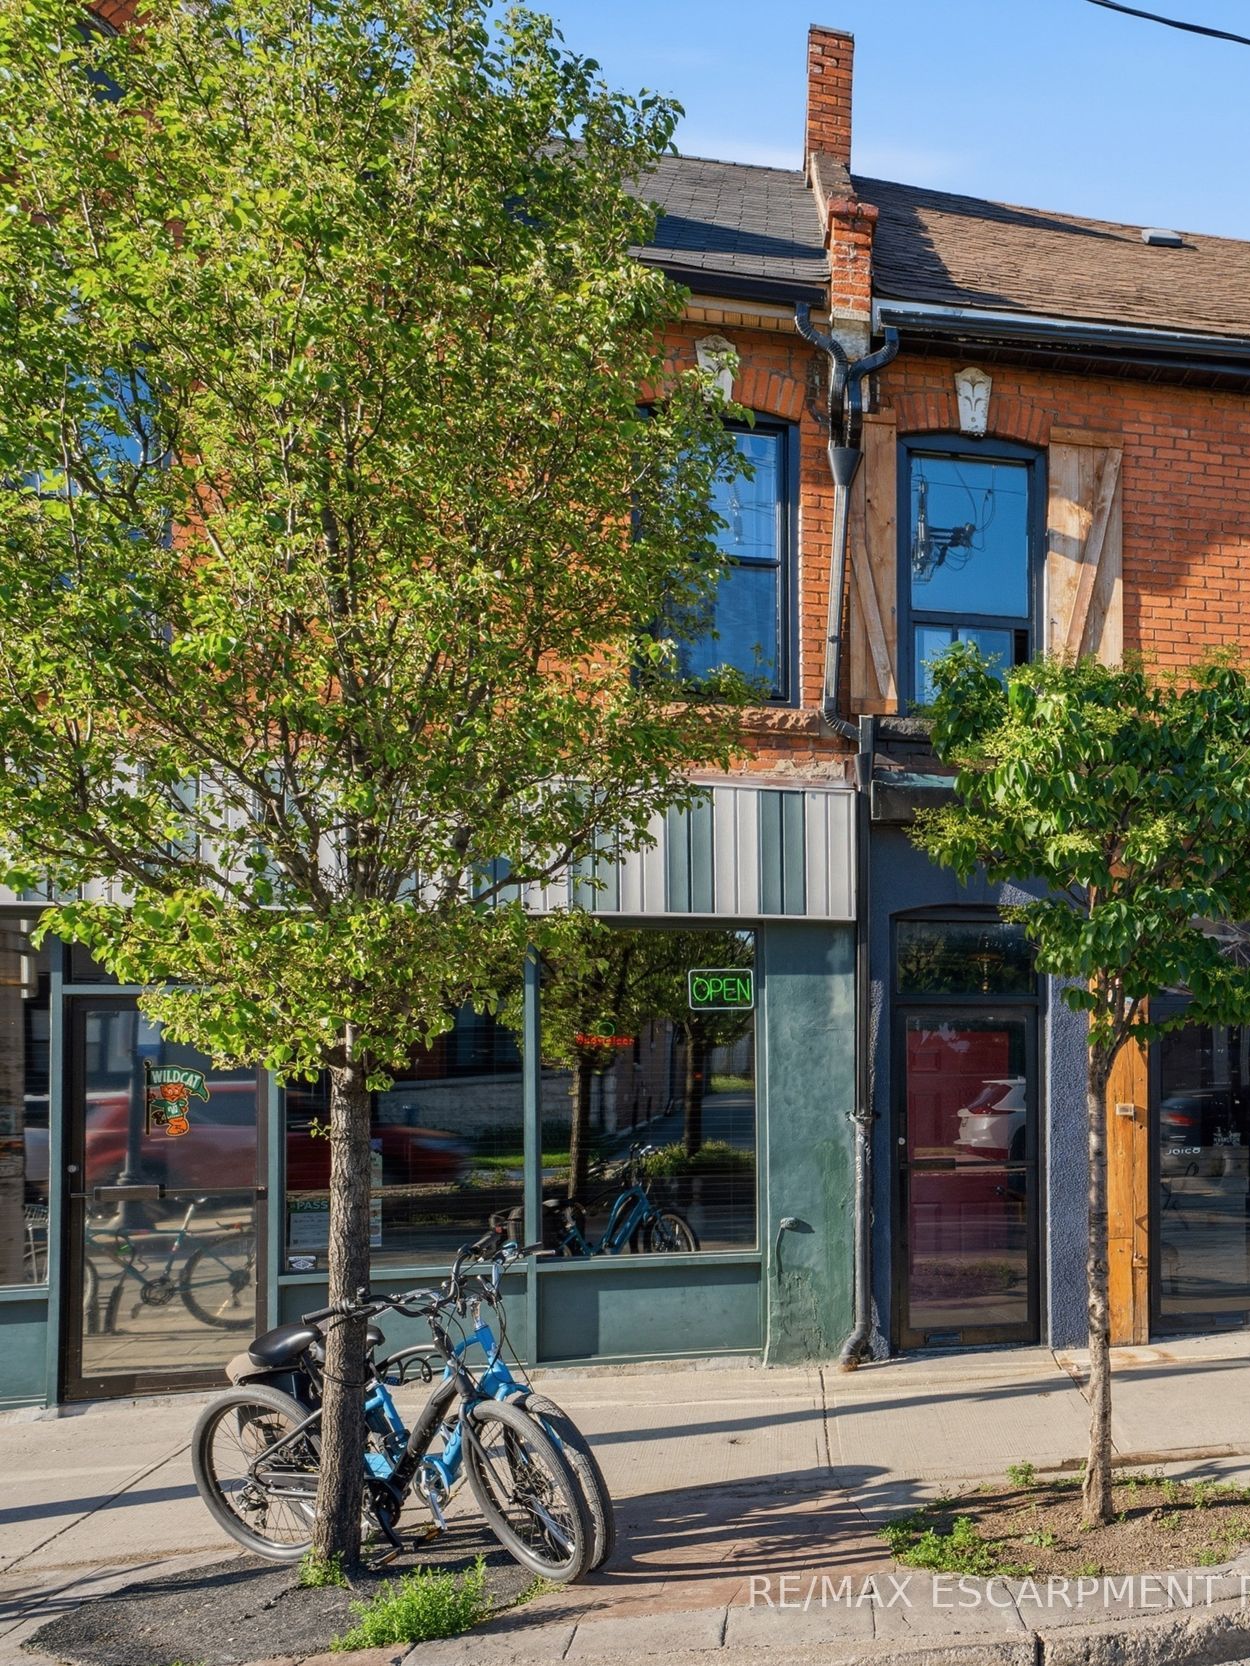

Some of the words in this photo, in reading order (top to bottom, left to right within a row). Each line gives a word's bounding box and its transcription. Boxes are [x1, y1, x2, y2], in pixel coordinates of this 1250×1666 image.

[692, 977, 751, 1002] OPEN
[151, 1069, 202, 1090] WILDCAT
[1167, 1147, 1201, 1155] JOICO
[296, 1200, 328, 1210] PASS
